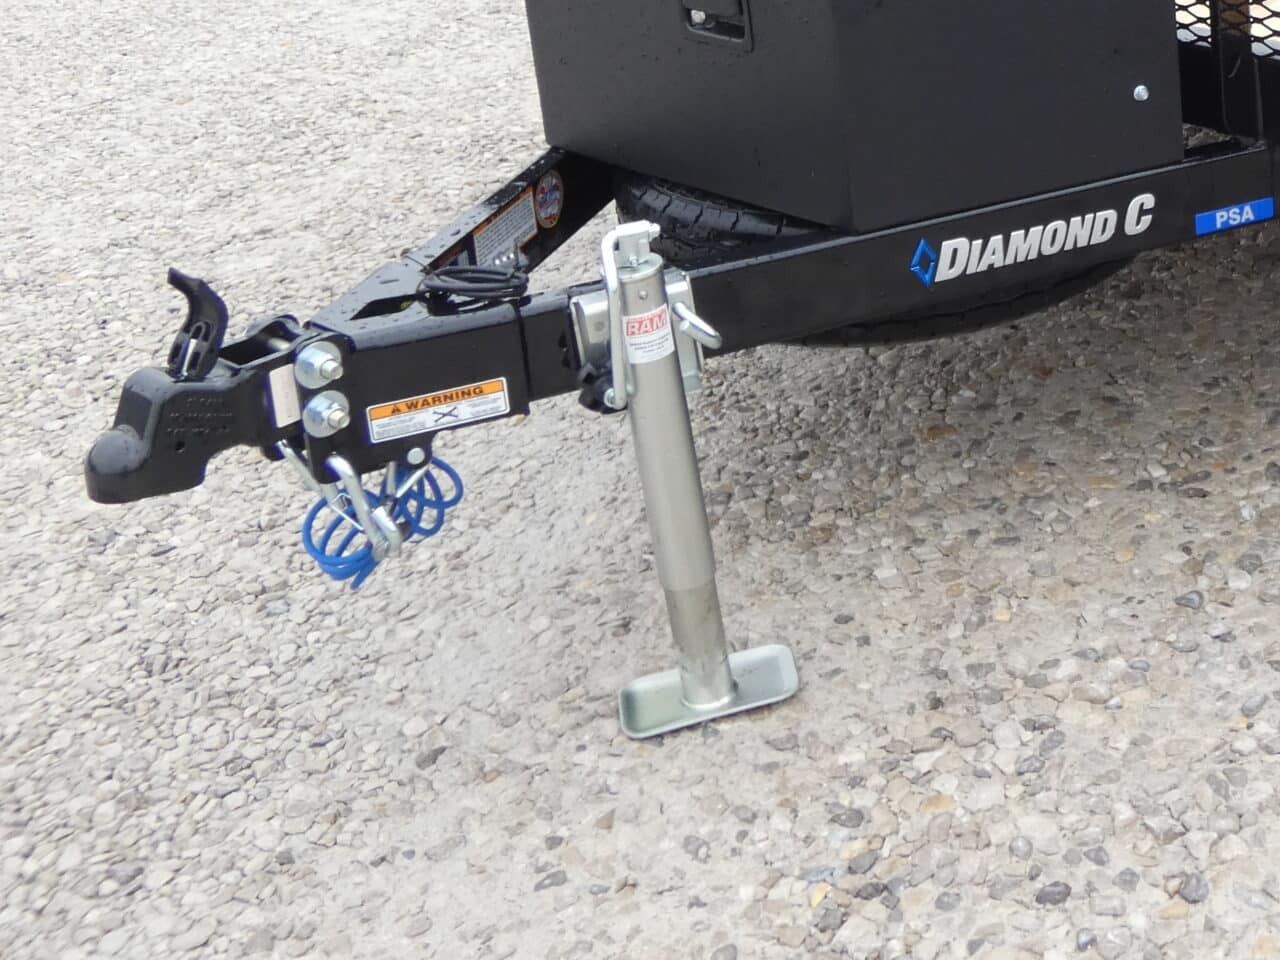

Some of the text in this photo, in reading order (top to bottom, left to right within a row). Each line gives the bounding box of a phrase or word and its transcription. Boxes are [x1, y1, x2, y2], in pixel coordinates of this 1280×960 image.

[1215, 205, 1255, 229] PSA
[934, 193, 1155, 283] DIAMOND C
[627, 309, 668, 336] RAM
[405, 386, 484, 411] WARNING
